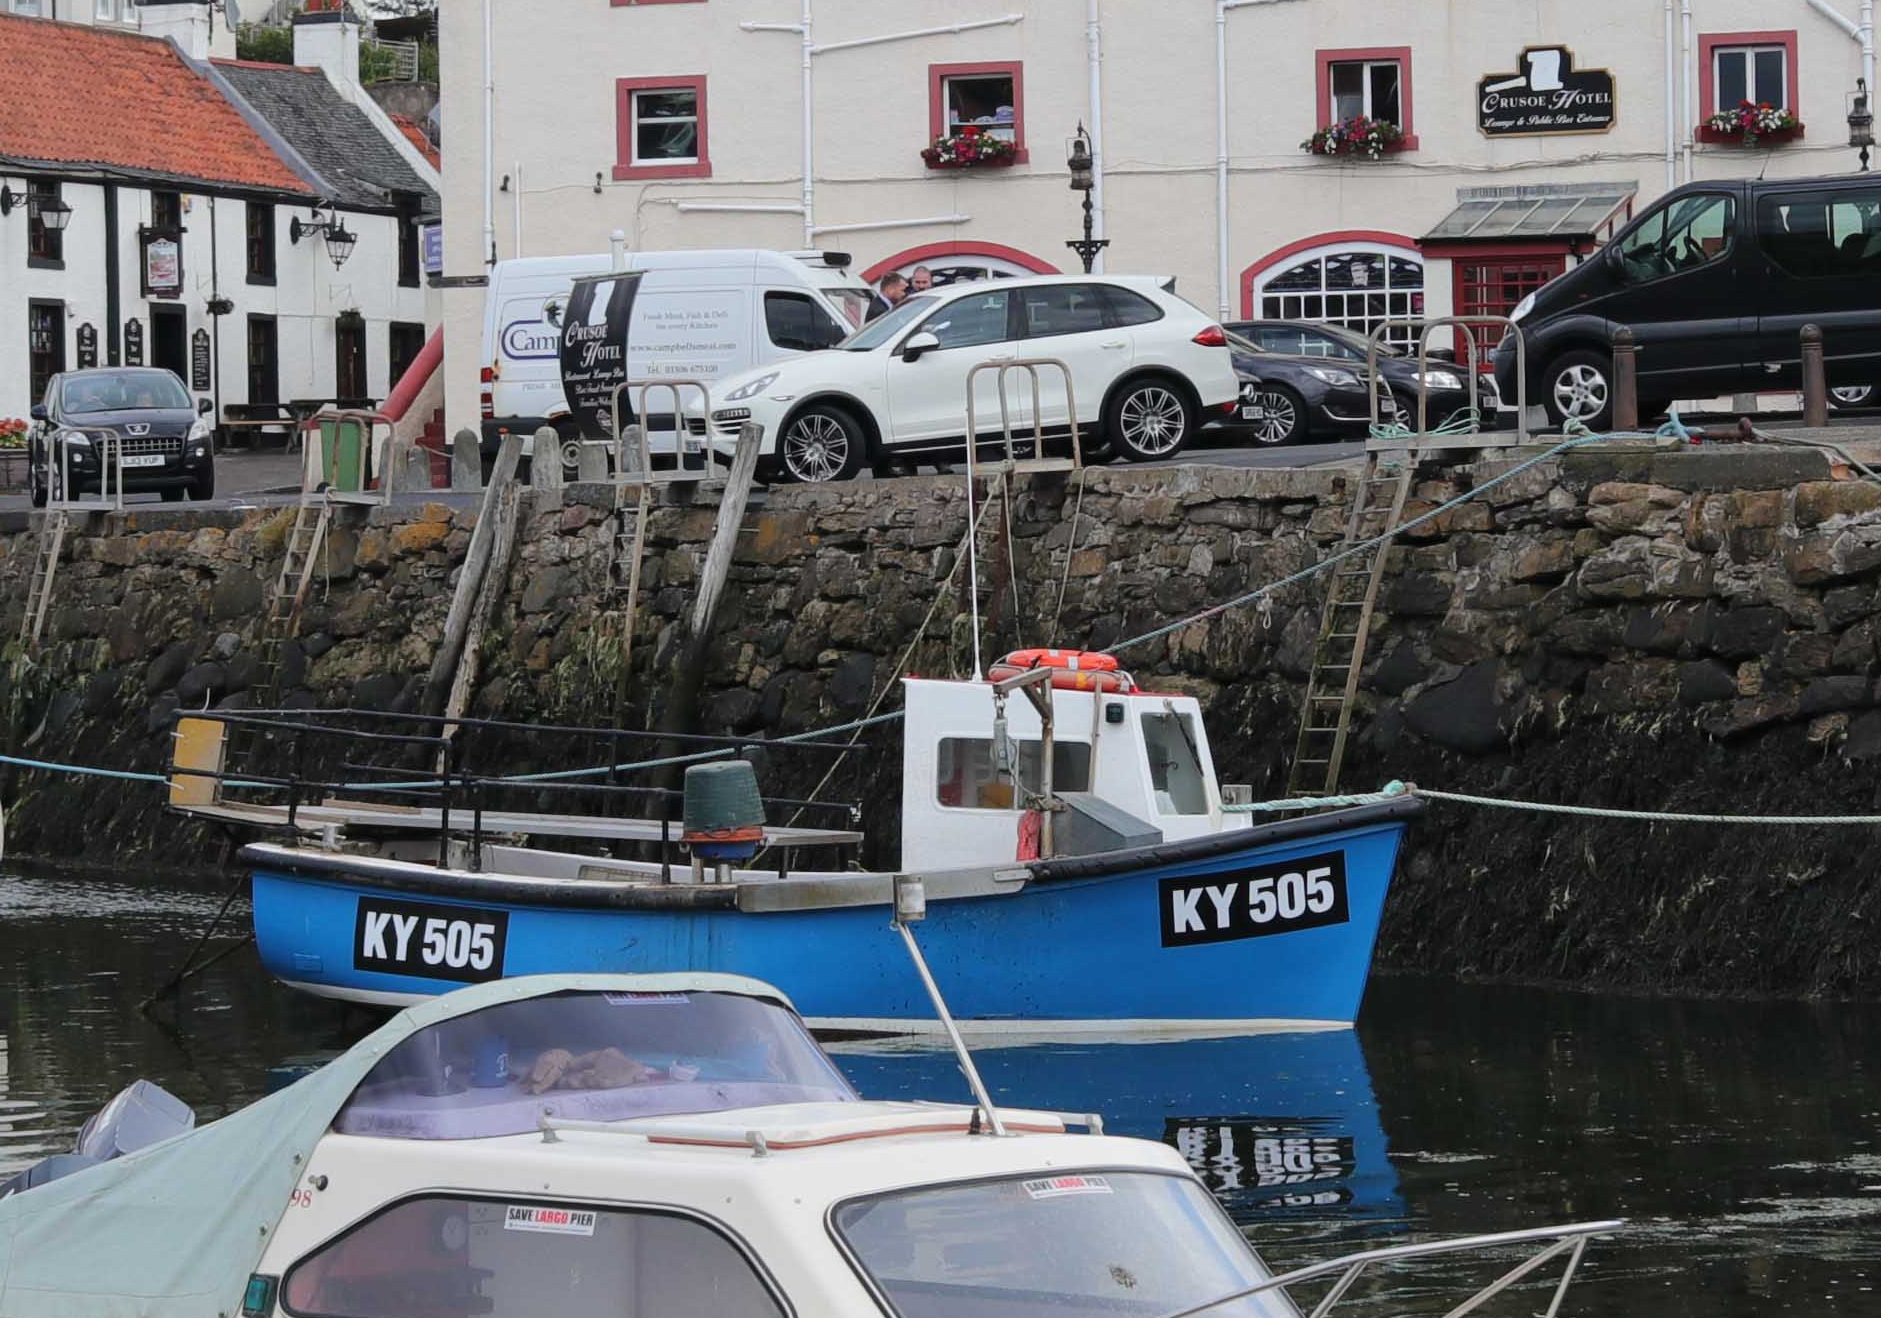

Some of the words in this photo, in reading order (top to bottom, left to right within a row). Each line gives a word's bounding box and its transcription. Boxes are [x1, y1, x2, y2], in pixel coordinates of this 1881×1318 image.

[1482, 93, 1546, 113] CRUSOE
[1548, 89, 1612, 110] HOTEL
[1555, 113, 1574, 124] Bar
[565, 321, 609, 348] CRUSOE
[580, 340, 622, 368] HOTEL
[1172, 882, 1239, 934] KY
[1248, 866, 1335, 924] 505
[363, 911, 419, 962] KY
[421, 917, 496, 971] 505
[509, 1208, 533, 1221] SAVE
[535, 1210, 569, 1224] LARGO
[570, 1213, 594, 1226] PIER
